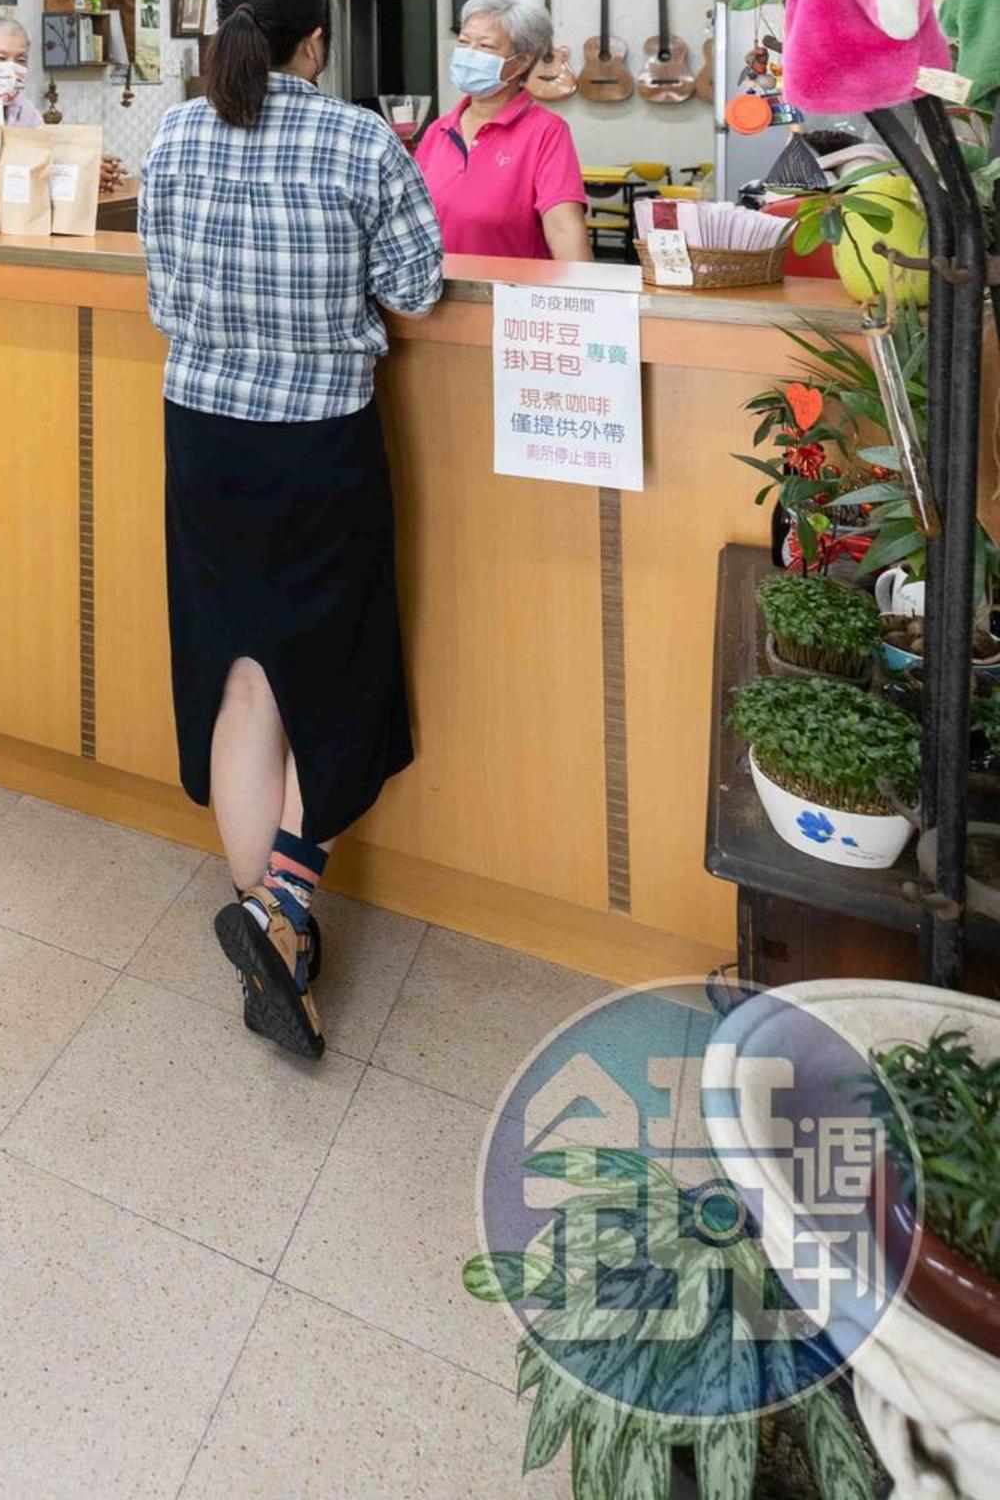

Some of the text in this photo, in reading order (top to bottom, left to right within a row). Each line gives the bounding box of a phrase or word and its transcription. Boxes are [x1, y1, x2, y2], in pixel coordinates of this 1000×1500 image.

[531, 293, 596, 314] 防疫期間
[503, 317, 582, 348] 咖啡豆
[502, 347, 583, 377] 掛耳包
[518, 387, 612, 417] 現煮咖啡
[510, 411, 626, 444] 僅提供外帶
